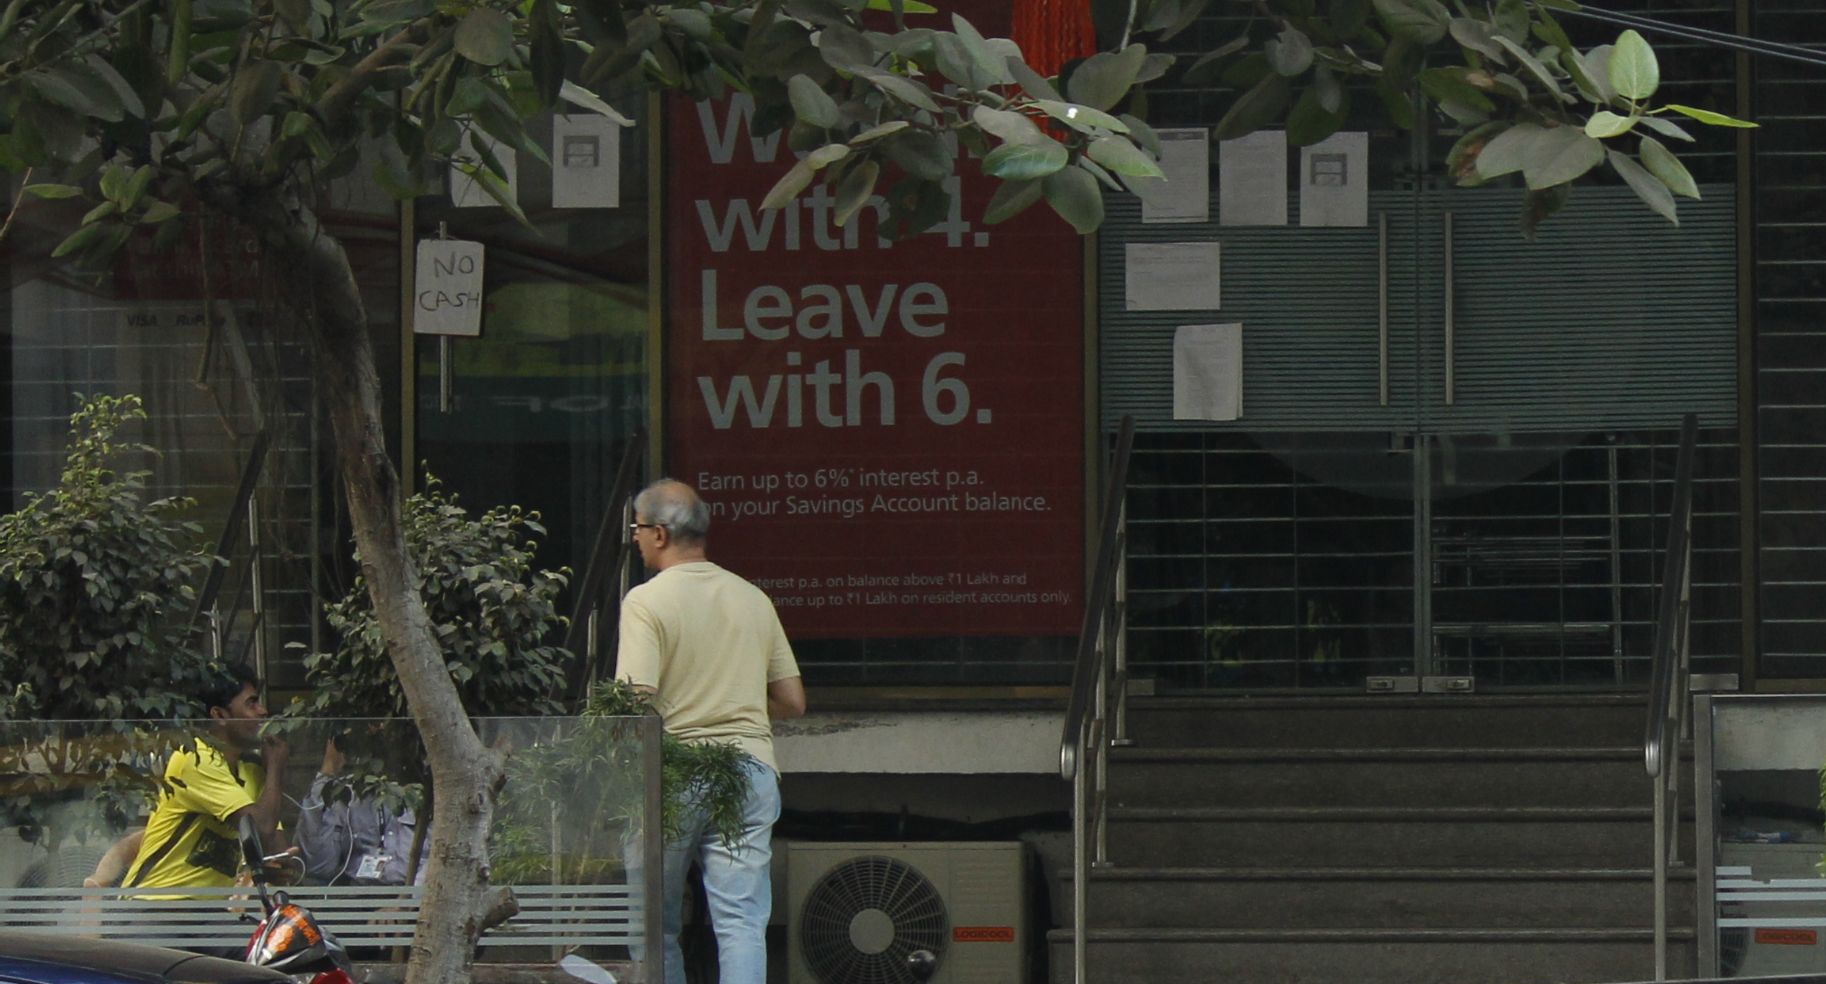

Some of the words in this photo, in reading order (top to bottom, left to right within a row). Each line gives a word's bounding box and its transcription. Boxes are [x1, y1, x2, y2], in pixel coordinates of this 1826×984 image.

[433, 251, 475, 278] NO
[419, 290, 480, 312] CASH
[702, 269, 949, 341] Leave
[696, 349, 895, 429] with
[921, 351, 992, 426] 6.
[698, 472, 745, 490] Earn
[752, 476, 780, 493] up
[785, 472, 808, 489] to
[859, 467, 940, 487] interest
[946, 470, 984, 490] p.a.
[732, 500, 781, 522] your
[786, 495, 865, 519] Savings
[869, 494, 959, 513] Account
[966, 491, 1052, 512] balance.
[826, 578, 844, 587] on
[848, 574, 900, 587] balance
[903, 573, 944, 586] above
[966, 573, 999, 585] Lakh
[1002, 572, 1027, 585] and
[807, 597, 821, 608] up
[829, 595, 843, 606] to
[865, 592, 898, 605] Lakh
[901, 594, 919, 605] on
[923, 591, 978, 604] resident
[981, 592, 1038, 604] accounts
